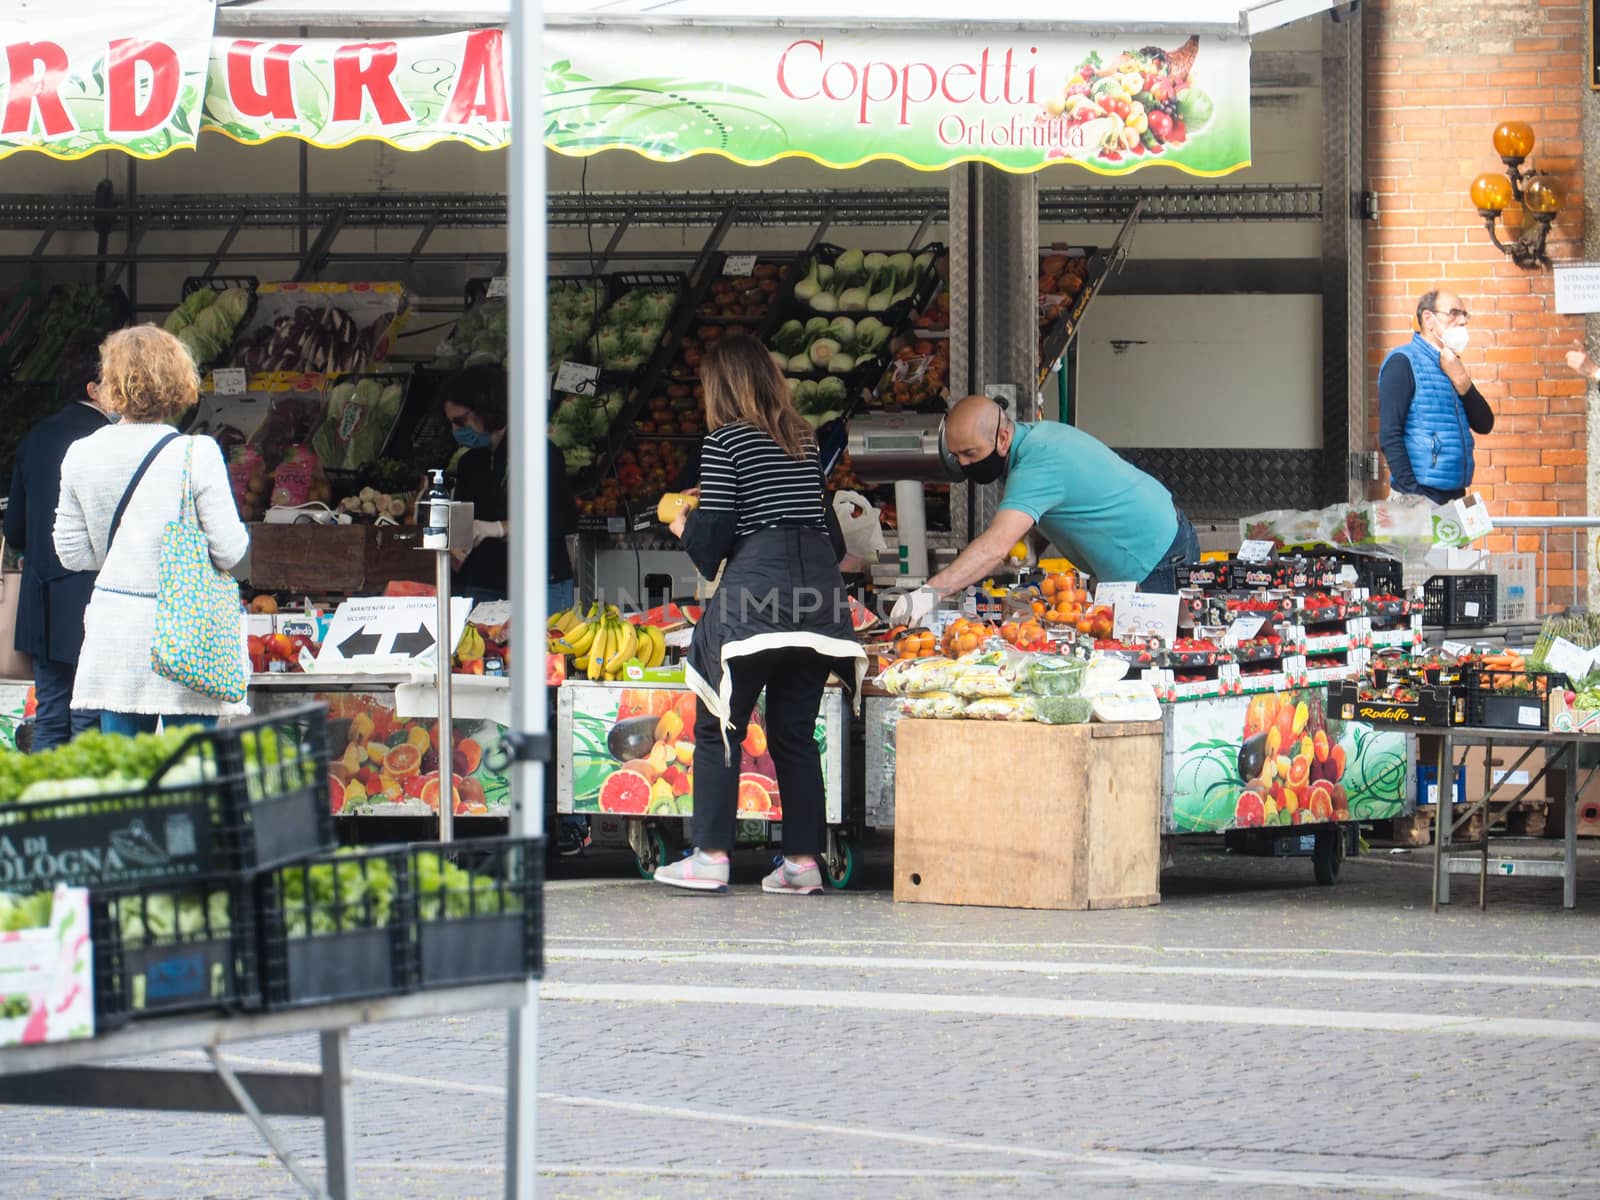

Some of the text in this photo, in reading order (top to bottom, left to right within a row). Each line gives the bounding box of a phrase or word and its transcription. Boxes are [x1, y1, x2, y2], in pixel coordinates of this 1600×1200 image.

[776, 38, 1040, 126] Coppetti
[937, 112, 1086, 148] Ortofrutta
[1360, 707, 1409, 721] Rodolfo
[24, 836, 48, 855] DI
